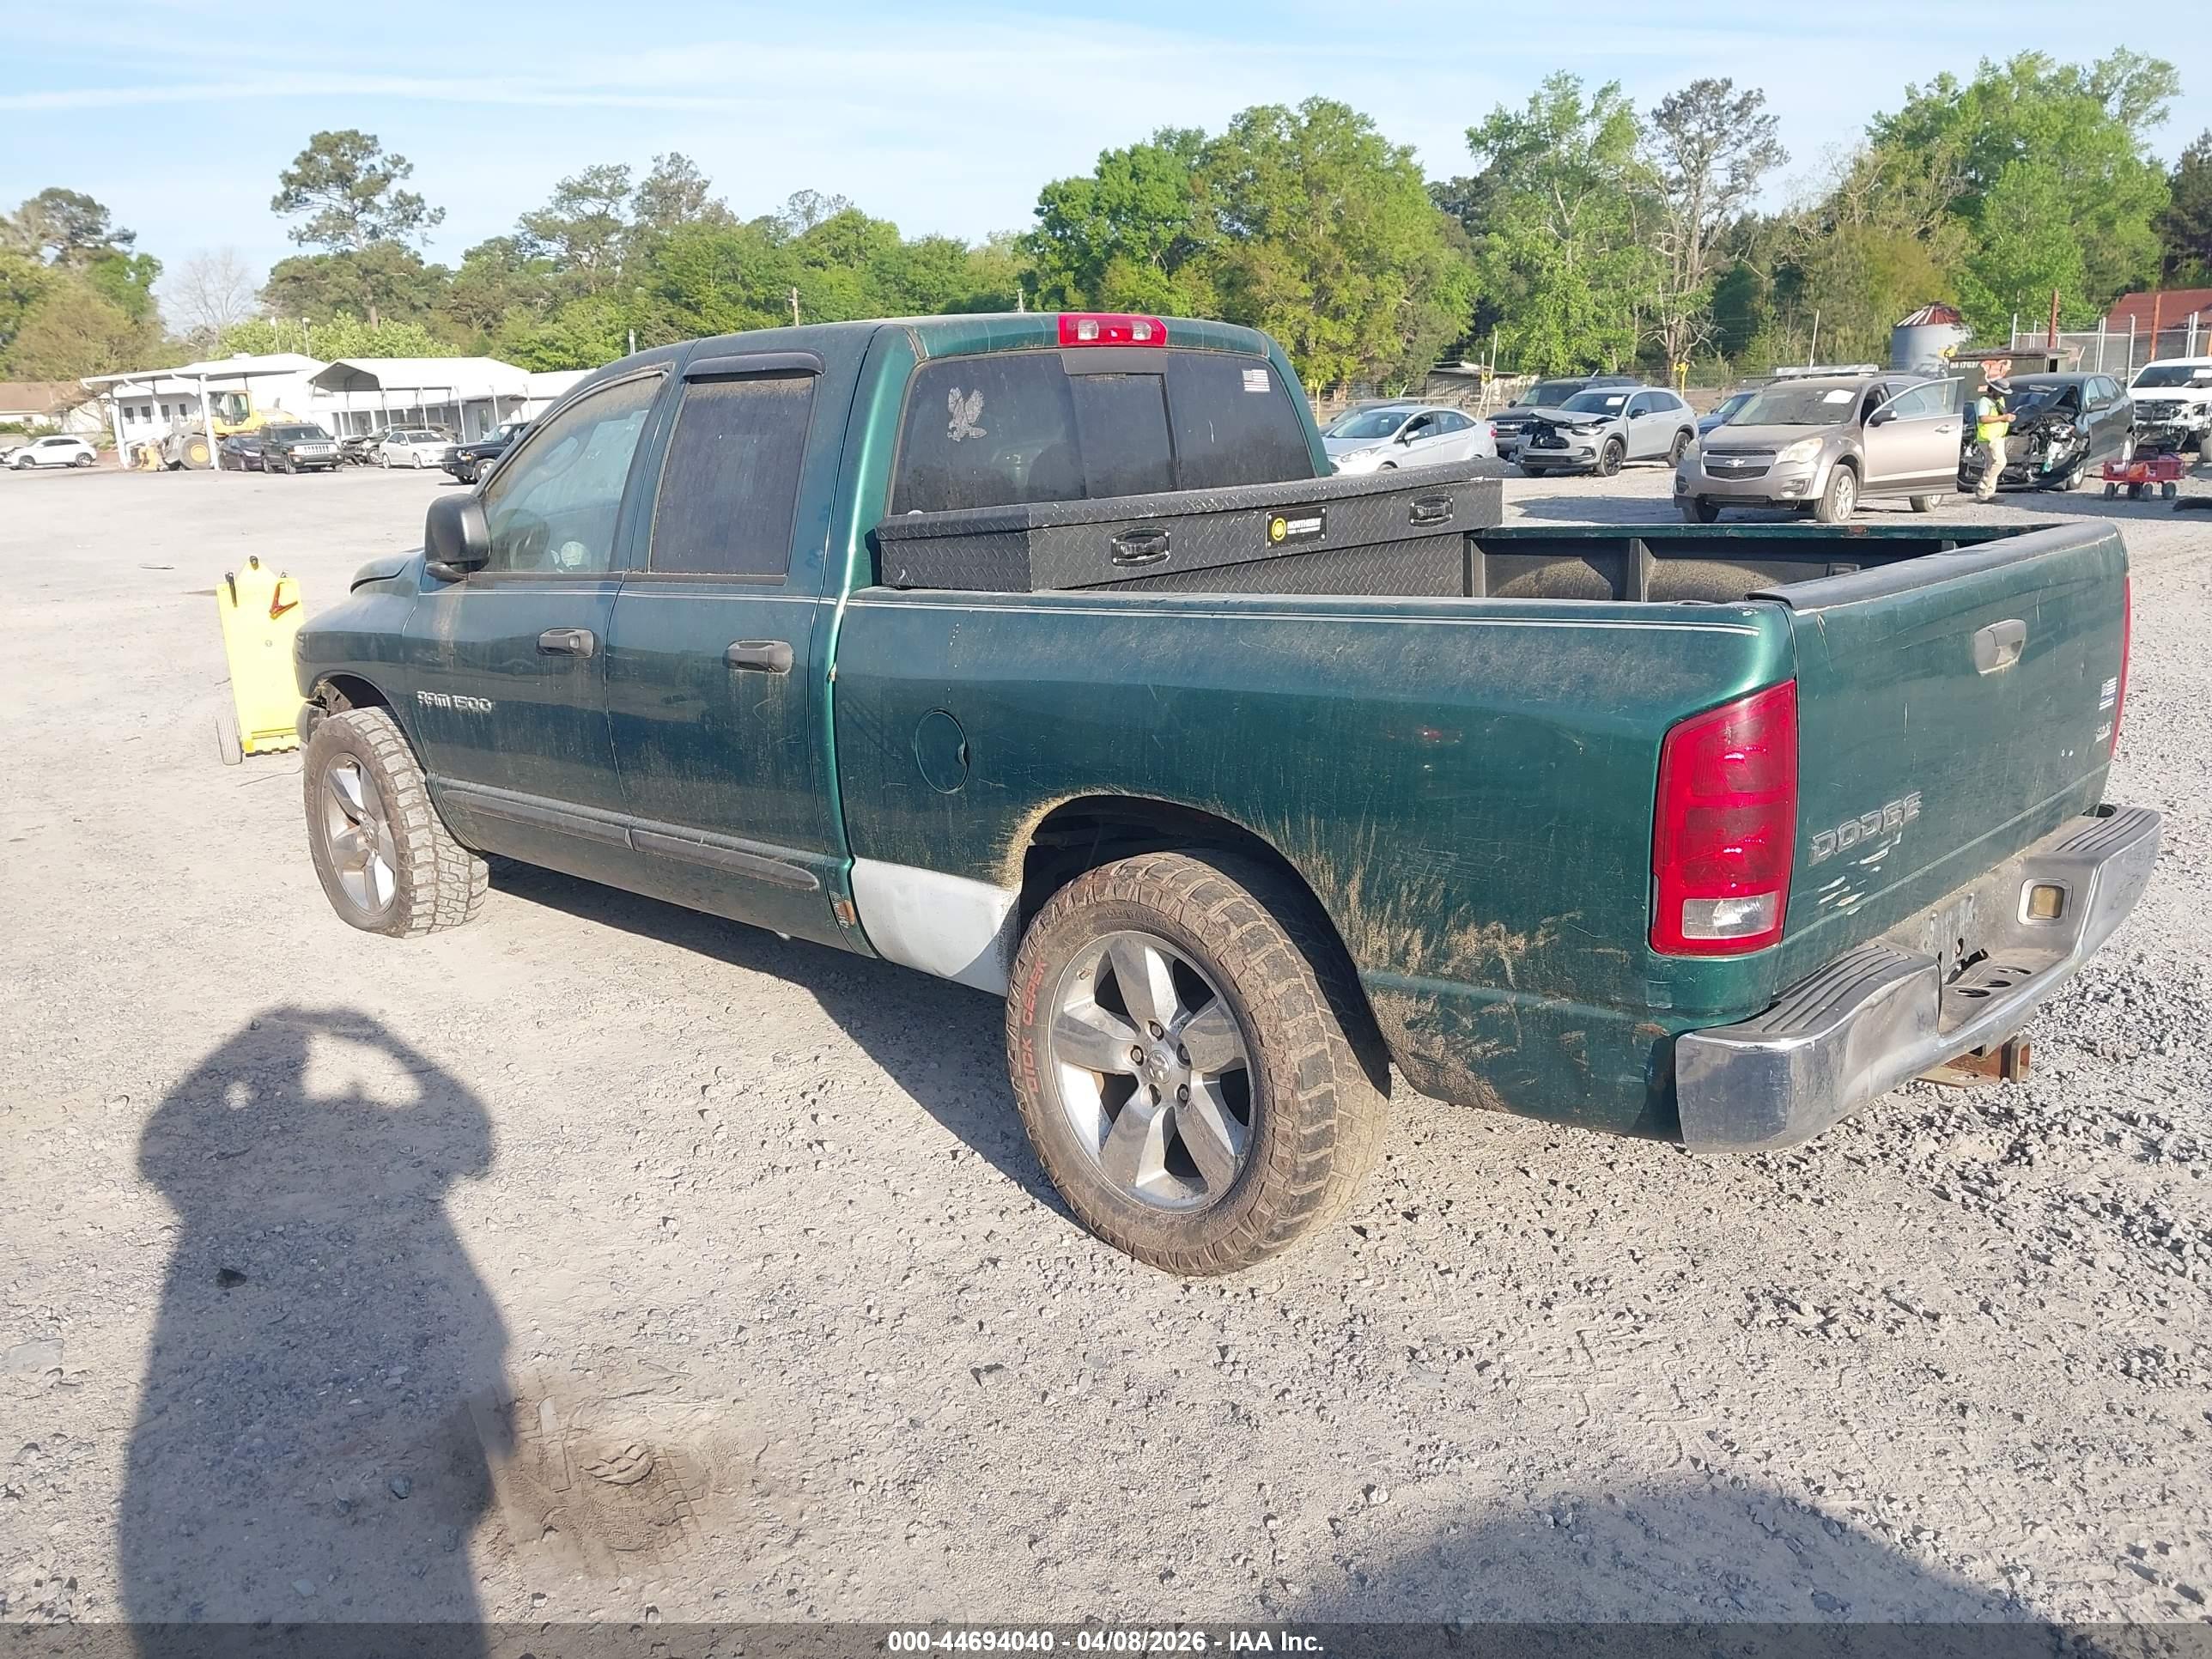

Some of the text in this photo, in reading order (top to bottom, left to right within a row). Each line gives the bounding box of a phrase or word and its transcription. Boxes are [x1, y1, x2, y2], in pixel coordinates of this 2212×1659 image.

[416, 690, 492, 713] RAM 1500
[1808, 791, 1923, 866] DODGE
[1022, 957, 1048, 1093] DICK CEPEK
